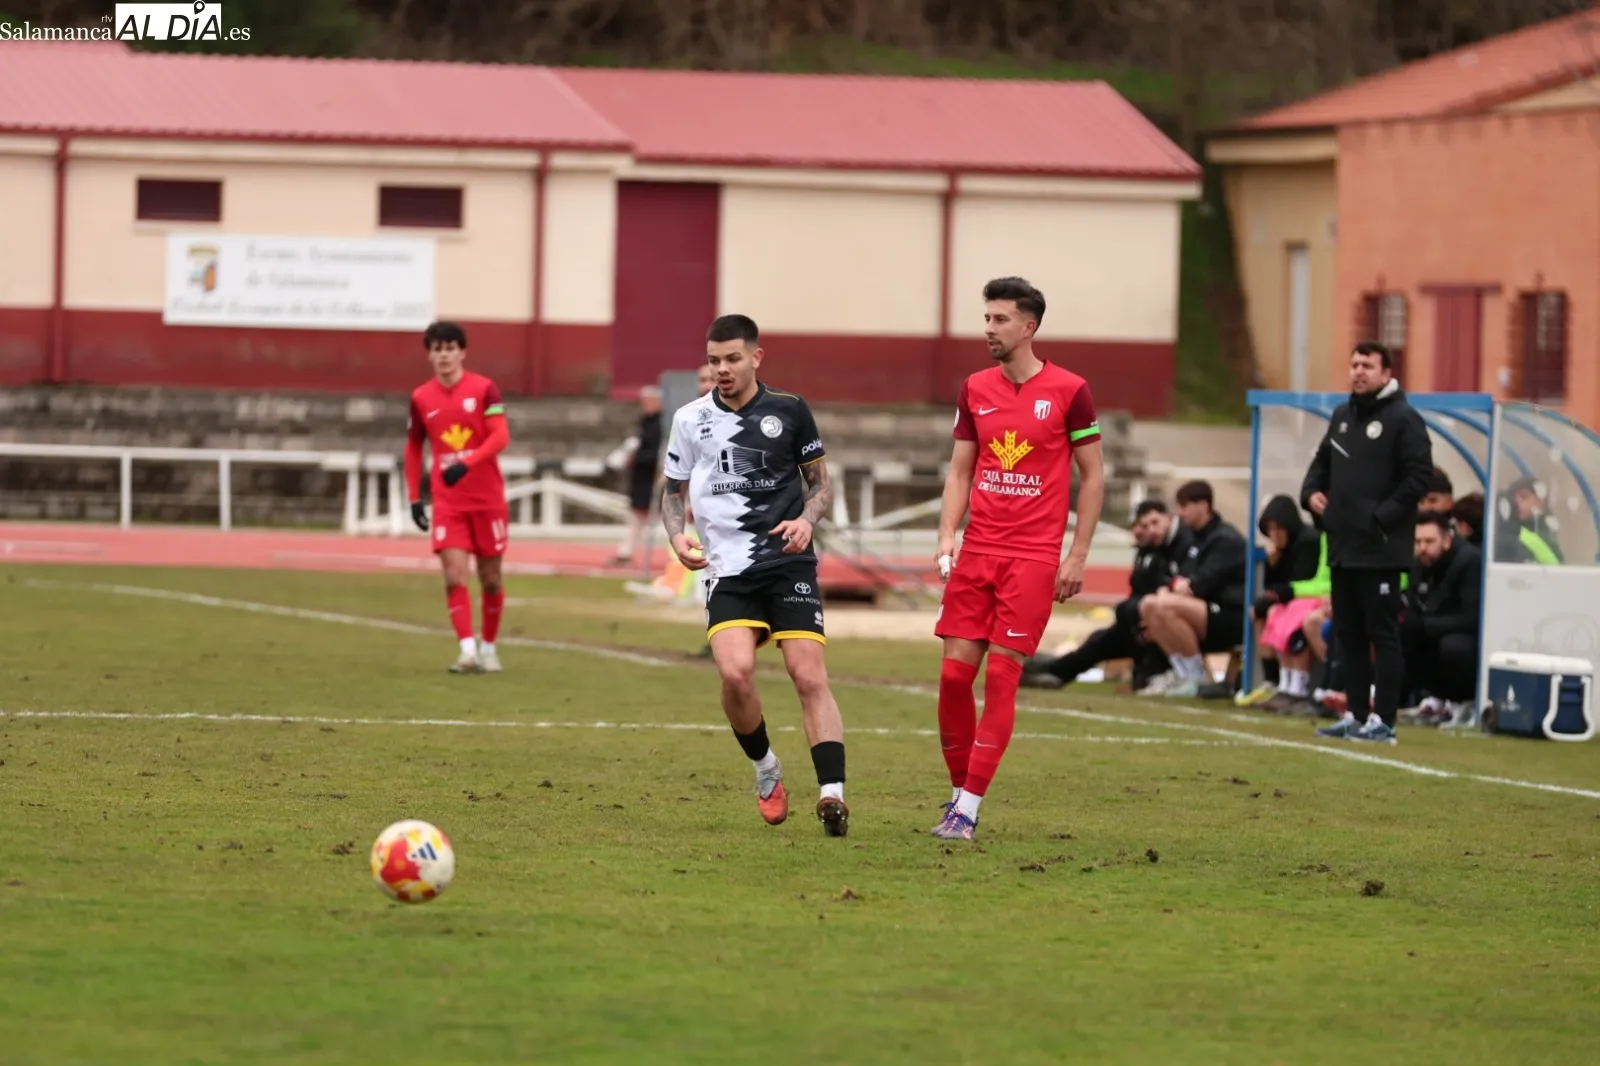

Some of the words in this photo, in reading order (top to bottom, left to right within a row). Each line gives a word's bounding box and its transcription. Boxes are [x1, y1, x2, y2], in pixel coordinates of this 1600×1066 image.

[982, 470, 1001, 483] CAJA
[1002, 473, 1042, 486] RURAL
[712, 480, 753, 492] HIERROS
